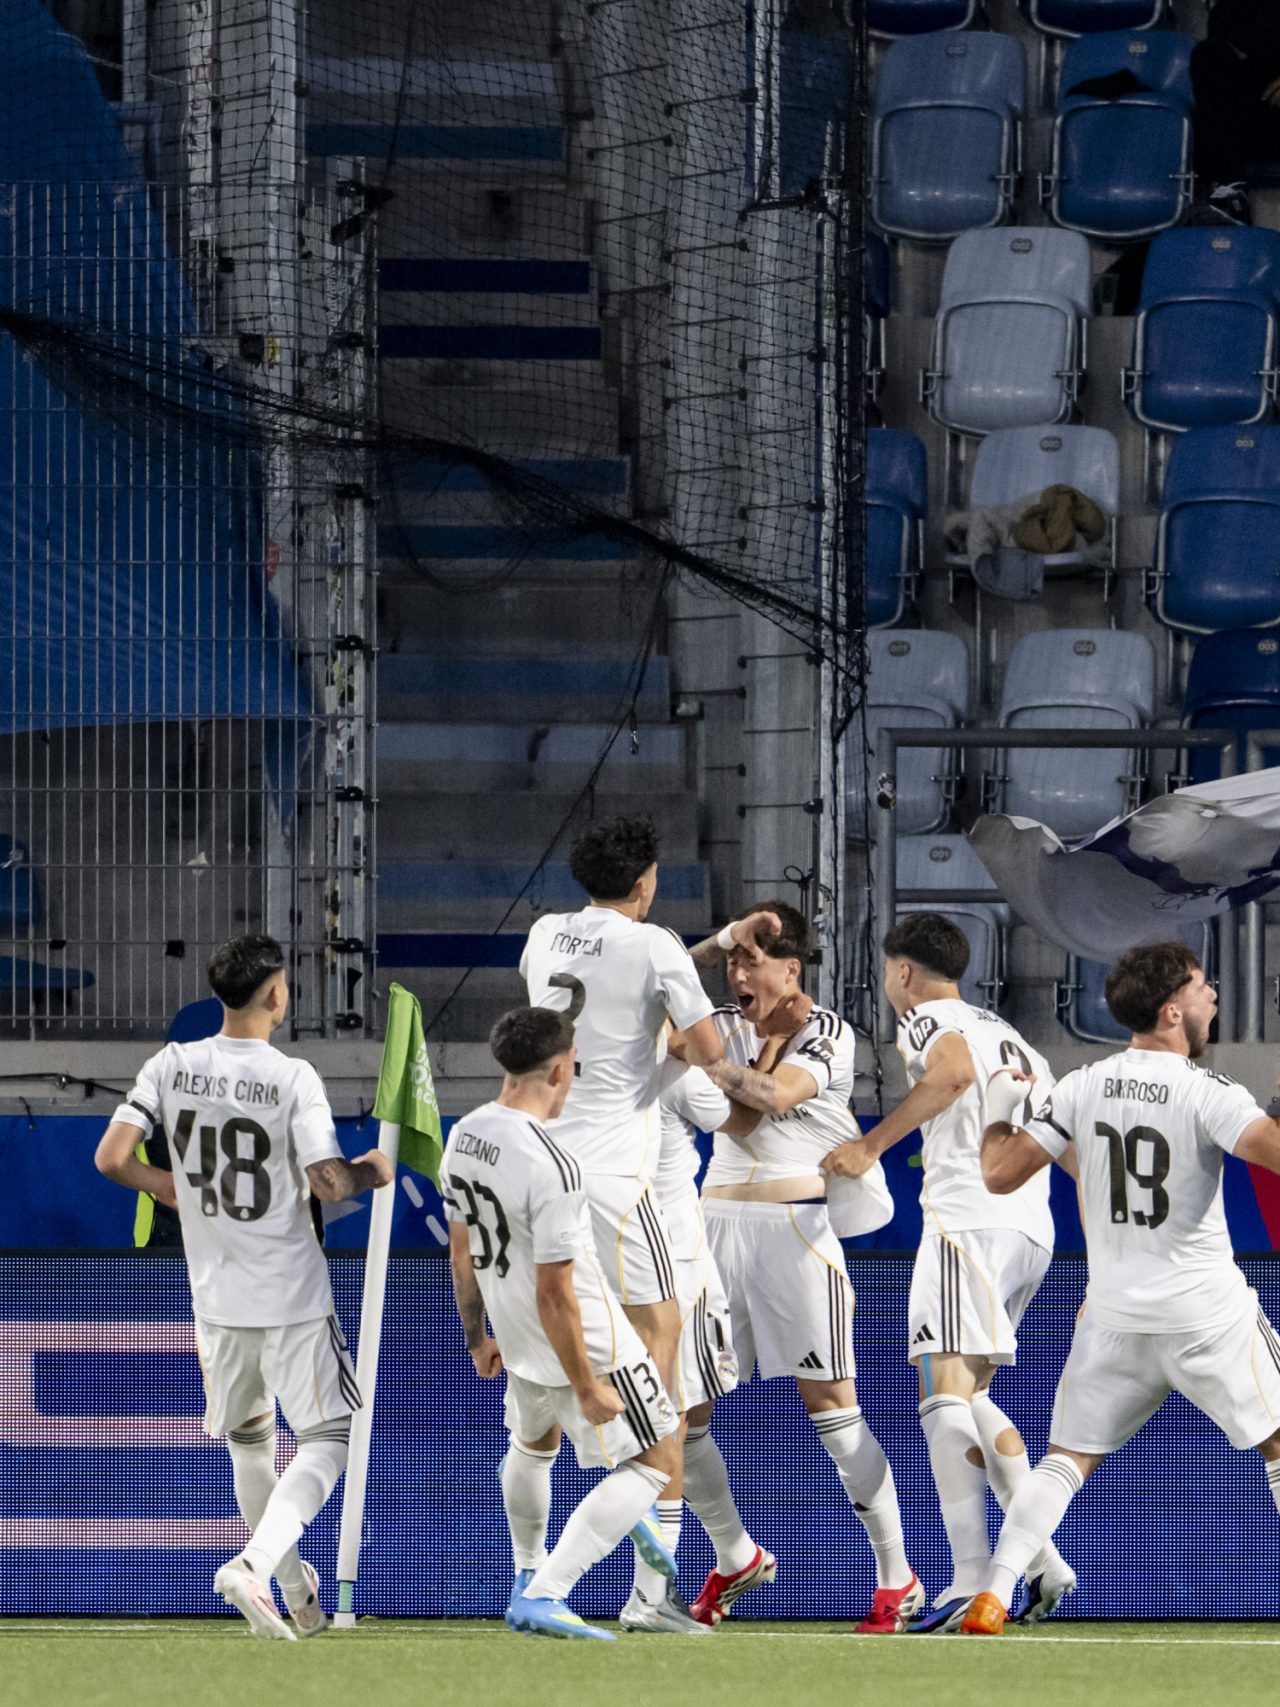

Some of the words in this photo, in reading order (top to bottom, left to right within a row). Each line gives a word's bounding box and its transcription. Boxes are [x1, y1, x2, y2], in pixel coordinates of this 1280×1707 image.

[173, 1071, 228, 1098] ALEXIS
[235, 1080, 280, 1106] CIRIA
[1104, 1078, 1169, 1104] BARROSO
[173, 1109, 272, 1222] 48
[1095, 1121, 1170, 1230] 19
